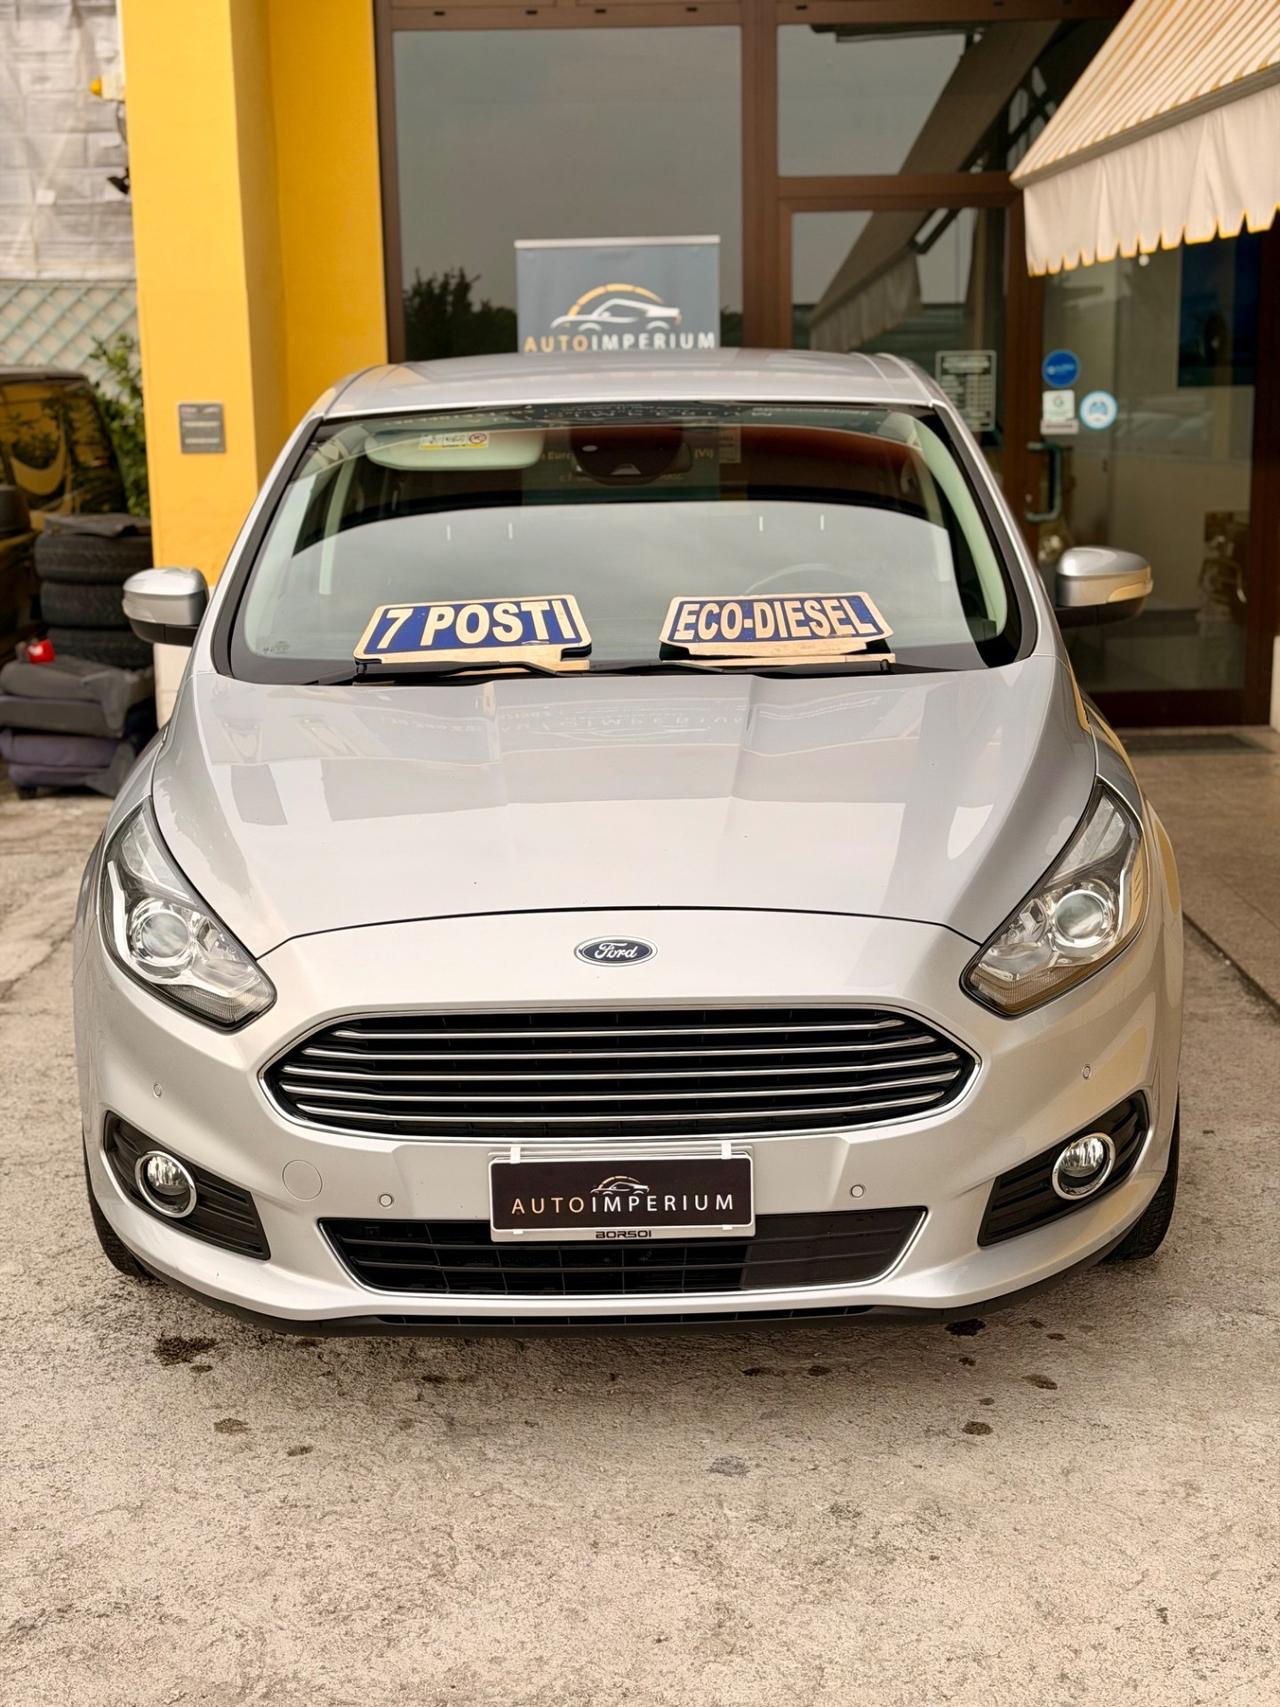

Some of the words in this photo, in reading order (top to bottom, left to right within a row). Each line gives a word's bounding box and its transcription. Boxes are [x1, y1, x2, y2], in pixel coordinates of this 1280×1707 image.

[524, 332, 715, 352] AUTOIMPERIUM
[377, 608, 413, 649] 7
[420, 600, 576, 647] POSTI
[673, 598, 877, 640] ECO-DIESEL
[594, 942, 638, 959] Ford
[511, 1193, 734, 1215] AUTOIMPERIUM
[595, 1230, 652, 1239] BORSOI
